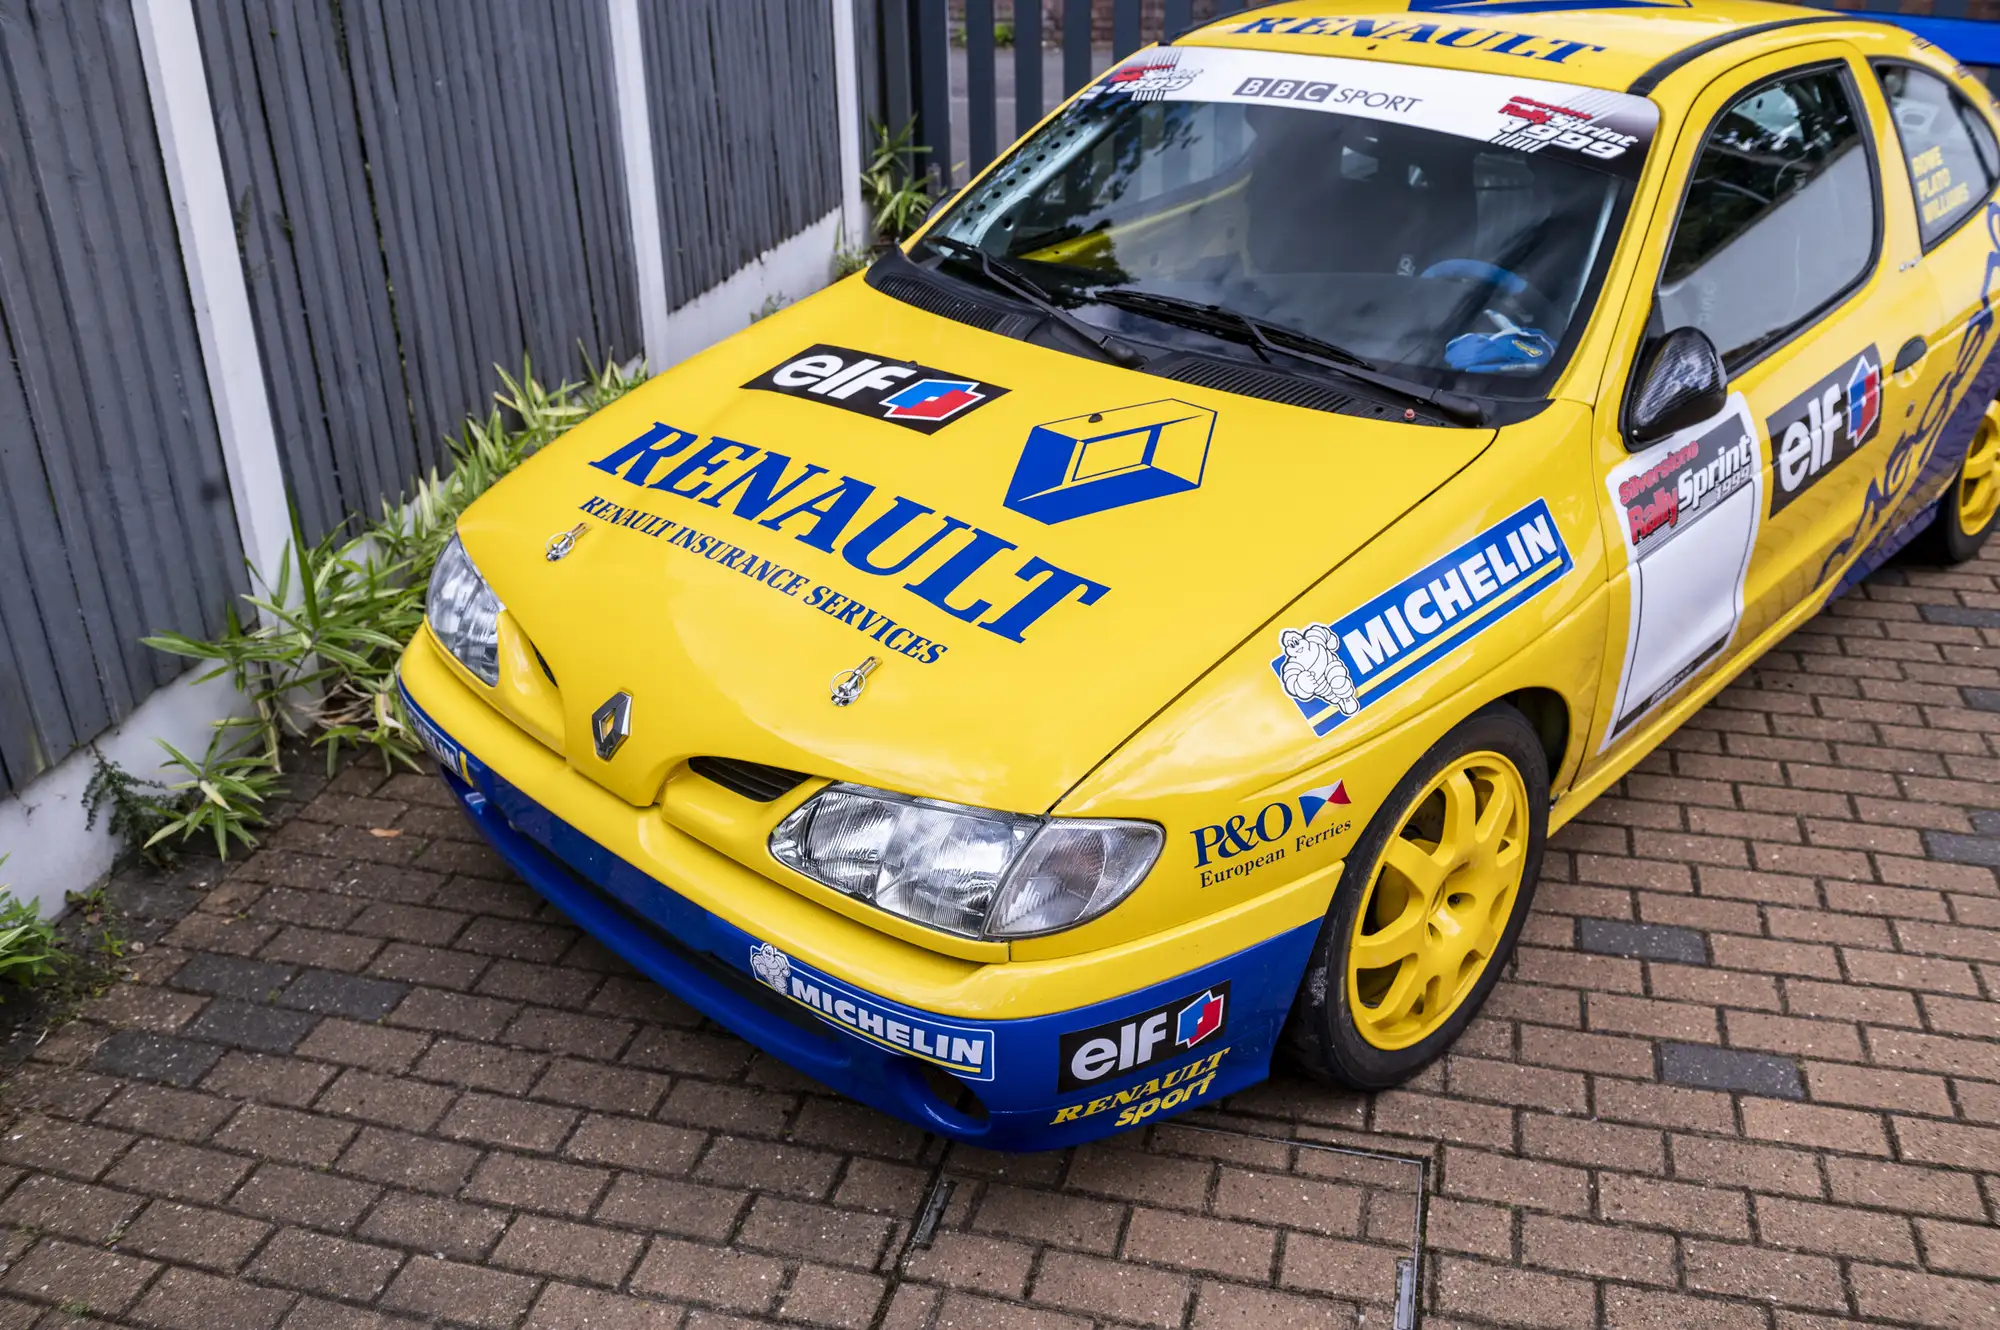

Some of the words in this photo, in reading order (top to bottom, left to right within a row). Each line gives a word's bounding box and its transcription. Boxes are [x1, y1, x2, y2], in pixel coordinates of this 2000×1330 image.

[1230, 17, 1607, 63] RENAULT
[1235, 77, 1337, 103] BBC
[1333, 88, 1423, 114] SPORT
[1499, 119, 1627, 160] 1999
[771, 353, 917, 400] elf
[1778, 383, 1843, 492] elf
[1619, 440, 1699, 505] Silverstone
[1627, 487, 1678, 546] Rally
[1678, 434, 1752, 513] Sprint
[1714, 465, 1750, 501] 1999
[587, 421, 1112, 644] RENAULT
[579, 495, 677, 538] RENAULT
[667, 526, 811, 597] INSURANCE
[803, 585, 949, 664] SERVICES
[1343, 514, 1557, 675] MICHELIN
[1190, 803, 1292, 869] P&O
[1200, 847, 1285, 889] European
[1295, 818, 1352, 853] Ferries
[791, 978, 985, 1064] MICHELIN
[1071, 1012, 1167, 1081] elf
[1050, 1047, 1231, 1125] RENAULT
[1115, 1070, 1216, 1127] sport
